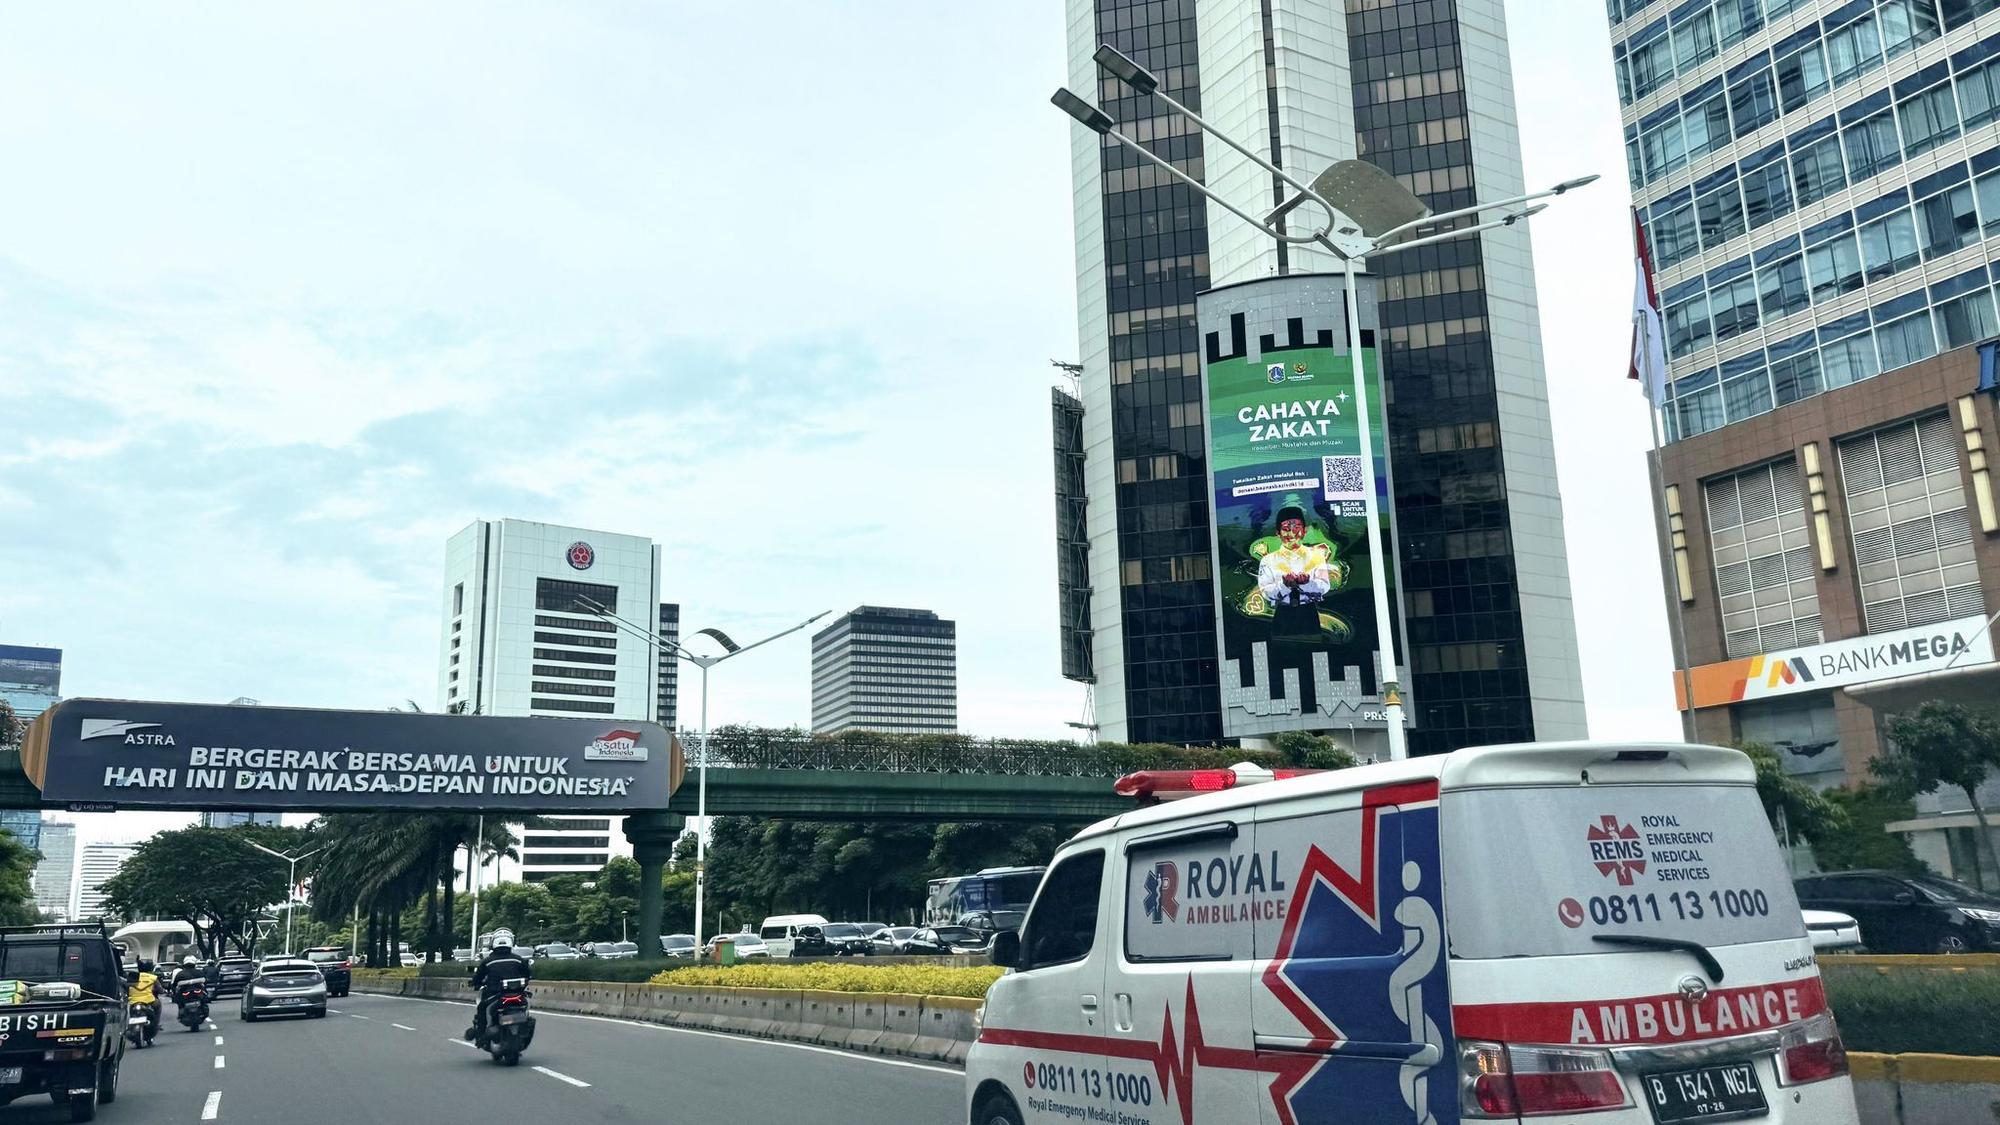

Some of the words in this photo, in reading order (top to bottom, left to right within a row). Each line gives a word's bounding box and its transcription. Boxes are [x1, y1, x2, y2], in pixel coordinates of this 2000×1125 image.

[1238, 399, 1340, 424] CAHAYA
[1249, 419, 1331, 442] ZAKAT
[124, 733, 176, 746] ASTRA
[189, 746, 339, 771] BERGERAK
[347, 751, 477, 773] BERSAMA
[484, 755, 568, 775] UNTUK
[103, 766, 176, 789] HARI
[186, 768, 227, 790] INI
[234, 770, 299, 792] DAN
[306, 772, 388, 793] MASA
[400, 774, 485, 795] DEPAN
[492, 775, 628, 796] INDONESIA
[1641, 815, 1680, 828] ROYAL
[1589, 840, 1644, 861] REMS
[1646, 832, 1714, 846] EMERGENCY
[1651, 850, 1704, 864] MEDICAL
[1187, 850, 1285, 899] ROYAL
[1657, 867, 1711, 882] SERVICES
[1186, 899, 1286, 925] AMBULANCE
[1588, 892, 1662, 926] 0811
[1669, 890, 1704, 921] 13
[1709, 888, 1769, 919] 1000
[1570, 987, 1802, 1045] AMBULANCE
[57, 1035, 88, 1043] COLT
[1038, 1062, 1076, 1094] 0811
[1081, 1068, 1101, 1099] 13
[1105, 1071, 1152, 1107] 1000
[1651, 1078, 1667, 1105] B
[1675, 1071, 1716, 1102] 1541
[1721, 1067, 1758, 1096] NGZ
[1028, 1096, 1047, 1113] Royal
[1047, 1099, 1087, 1121] Emergency
[1087, 1105, 1117, 1124] Medical
[1117, 1111, 1151, 1125] Services
